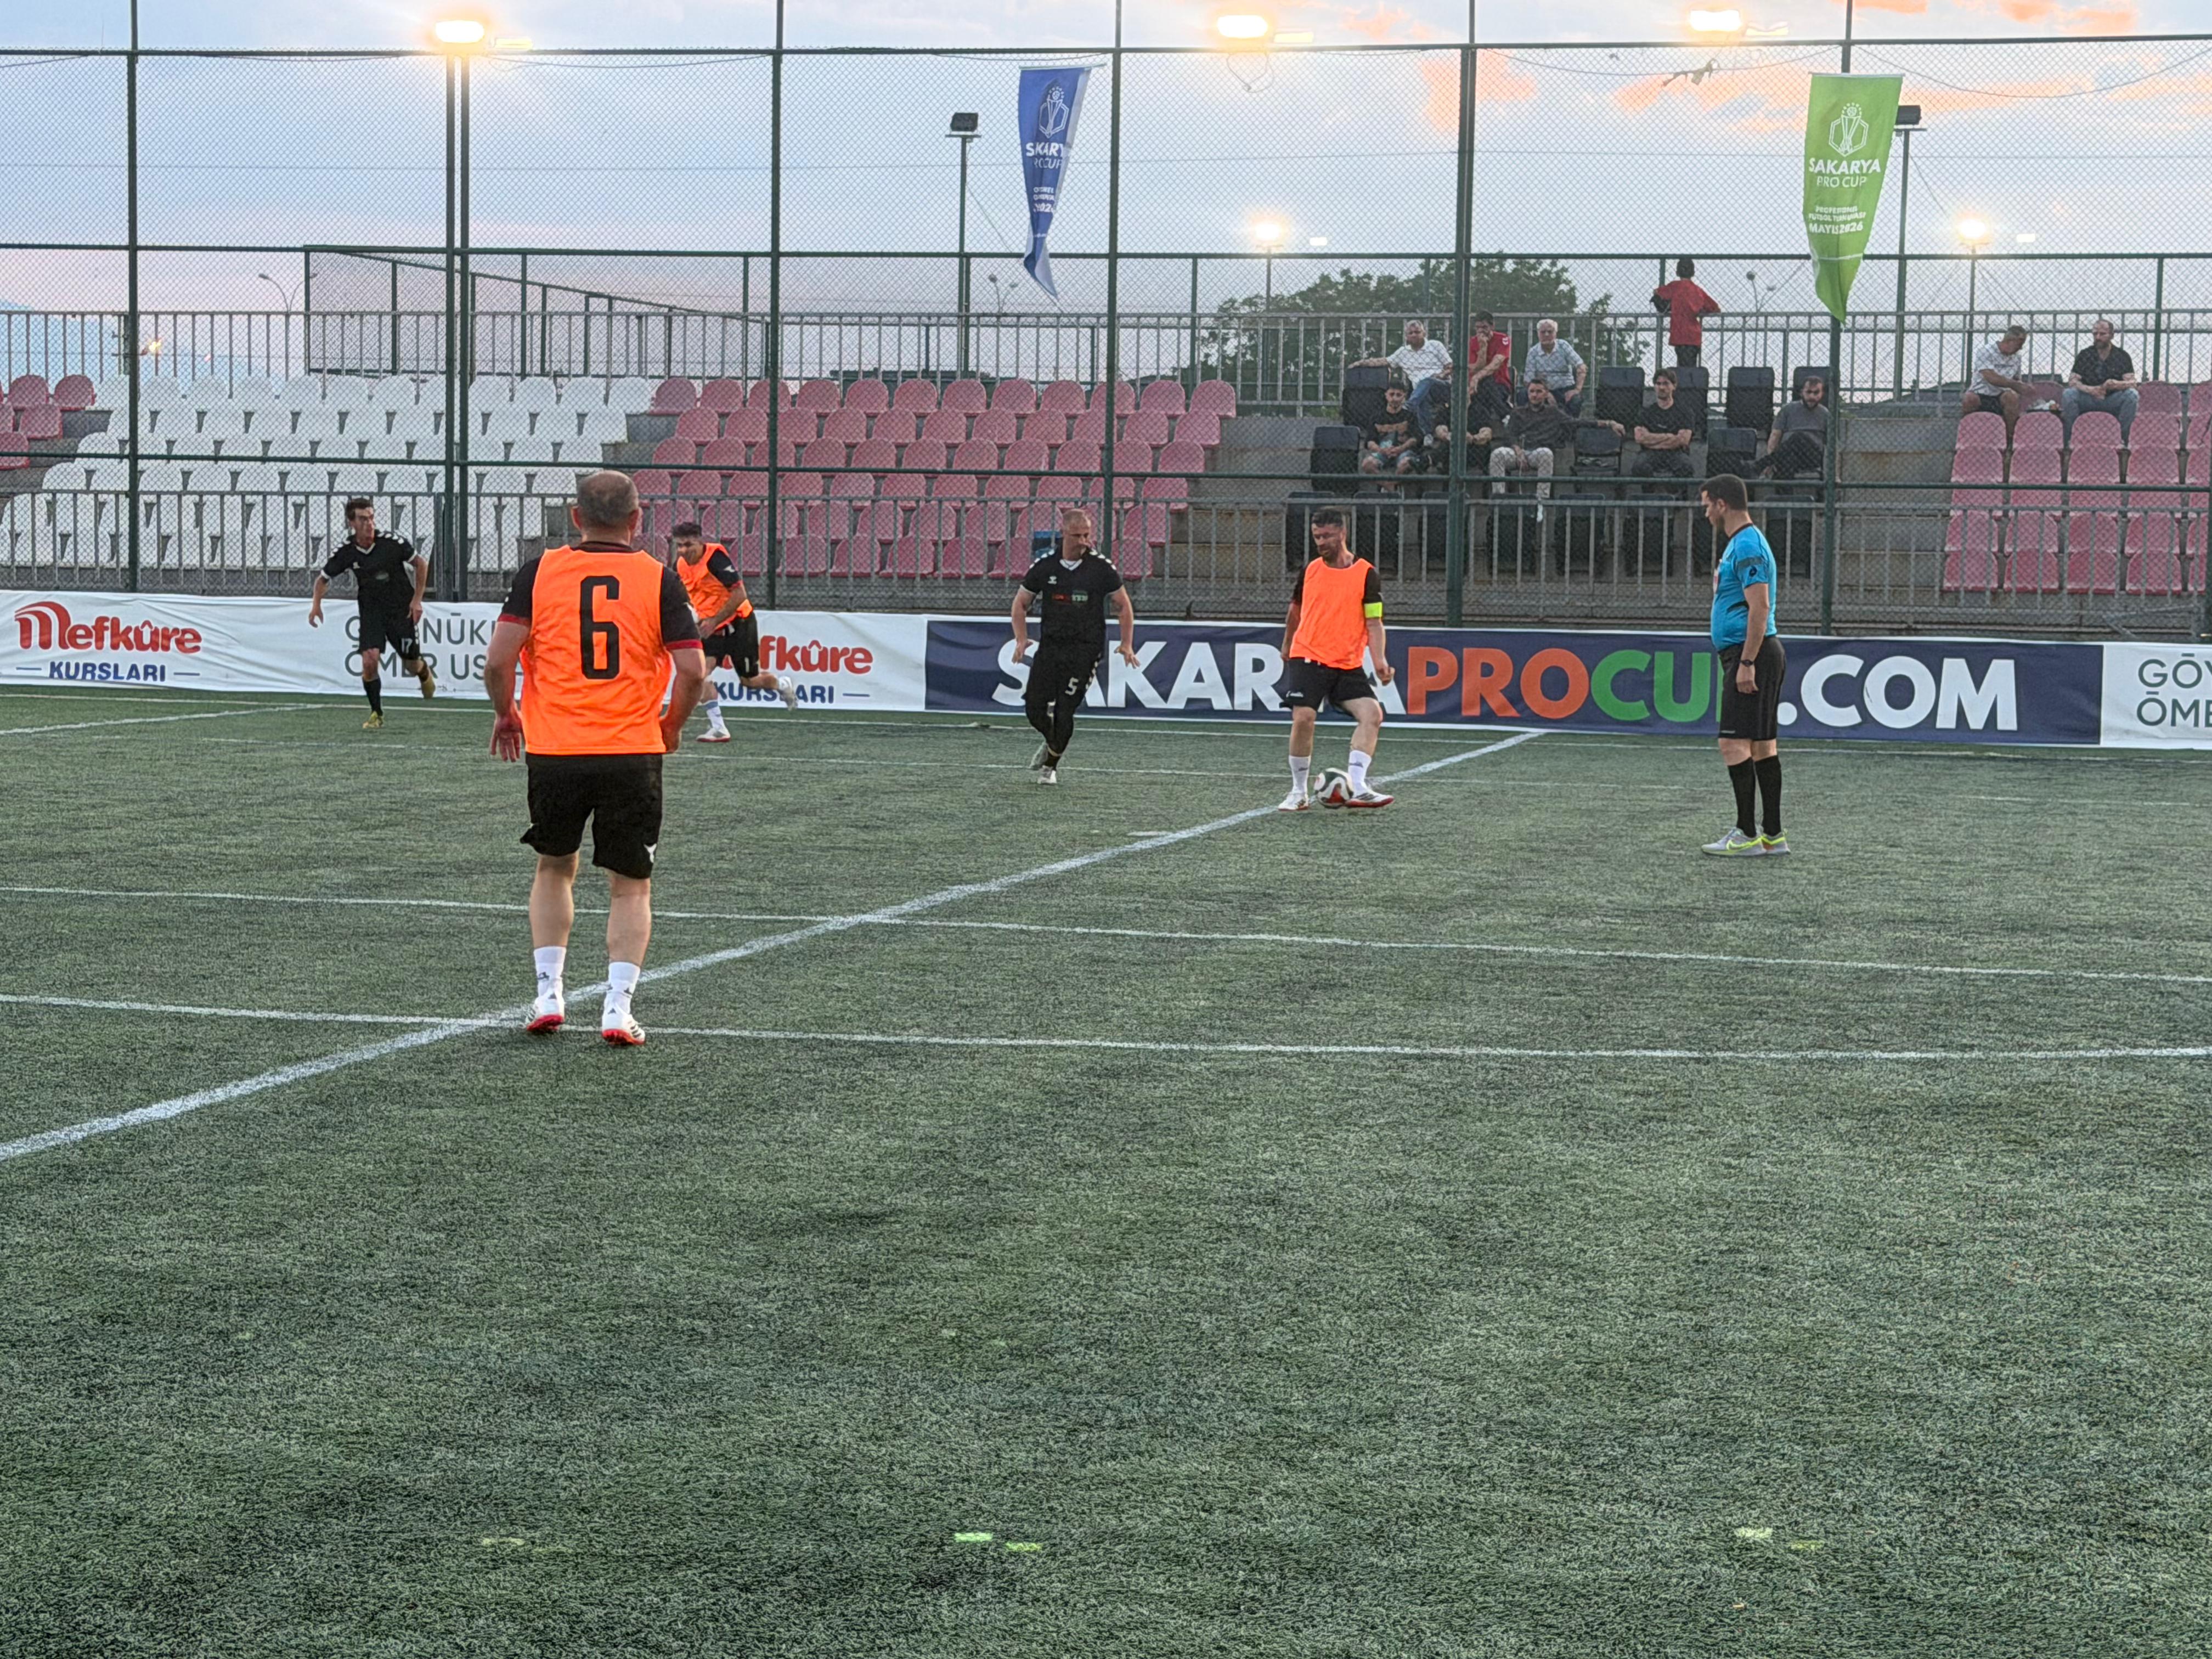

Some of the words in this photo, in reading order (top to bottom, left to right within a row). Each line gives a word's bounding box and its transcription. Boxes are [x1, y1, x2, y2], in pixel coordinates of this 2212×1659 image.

[1809, 157, 1881, 174] SAKARYA
[1816, 176, 1840, 188] PRO
[1841, 175, 1867, 188] CUP
[579, 575, 620, 680] 6
[401, 637, 413, 654] 17
[722, 635, 873, 675] fkûre
[48, 661, 166, 682] KURSLARI
[714, 681, 834, 704] KURSARI
[1064, 676, 1079, 696] 5
